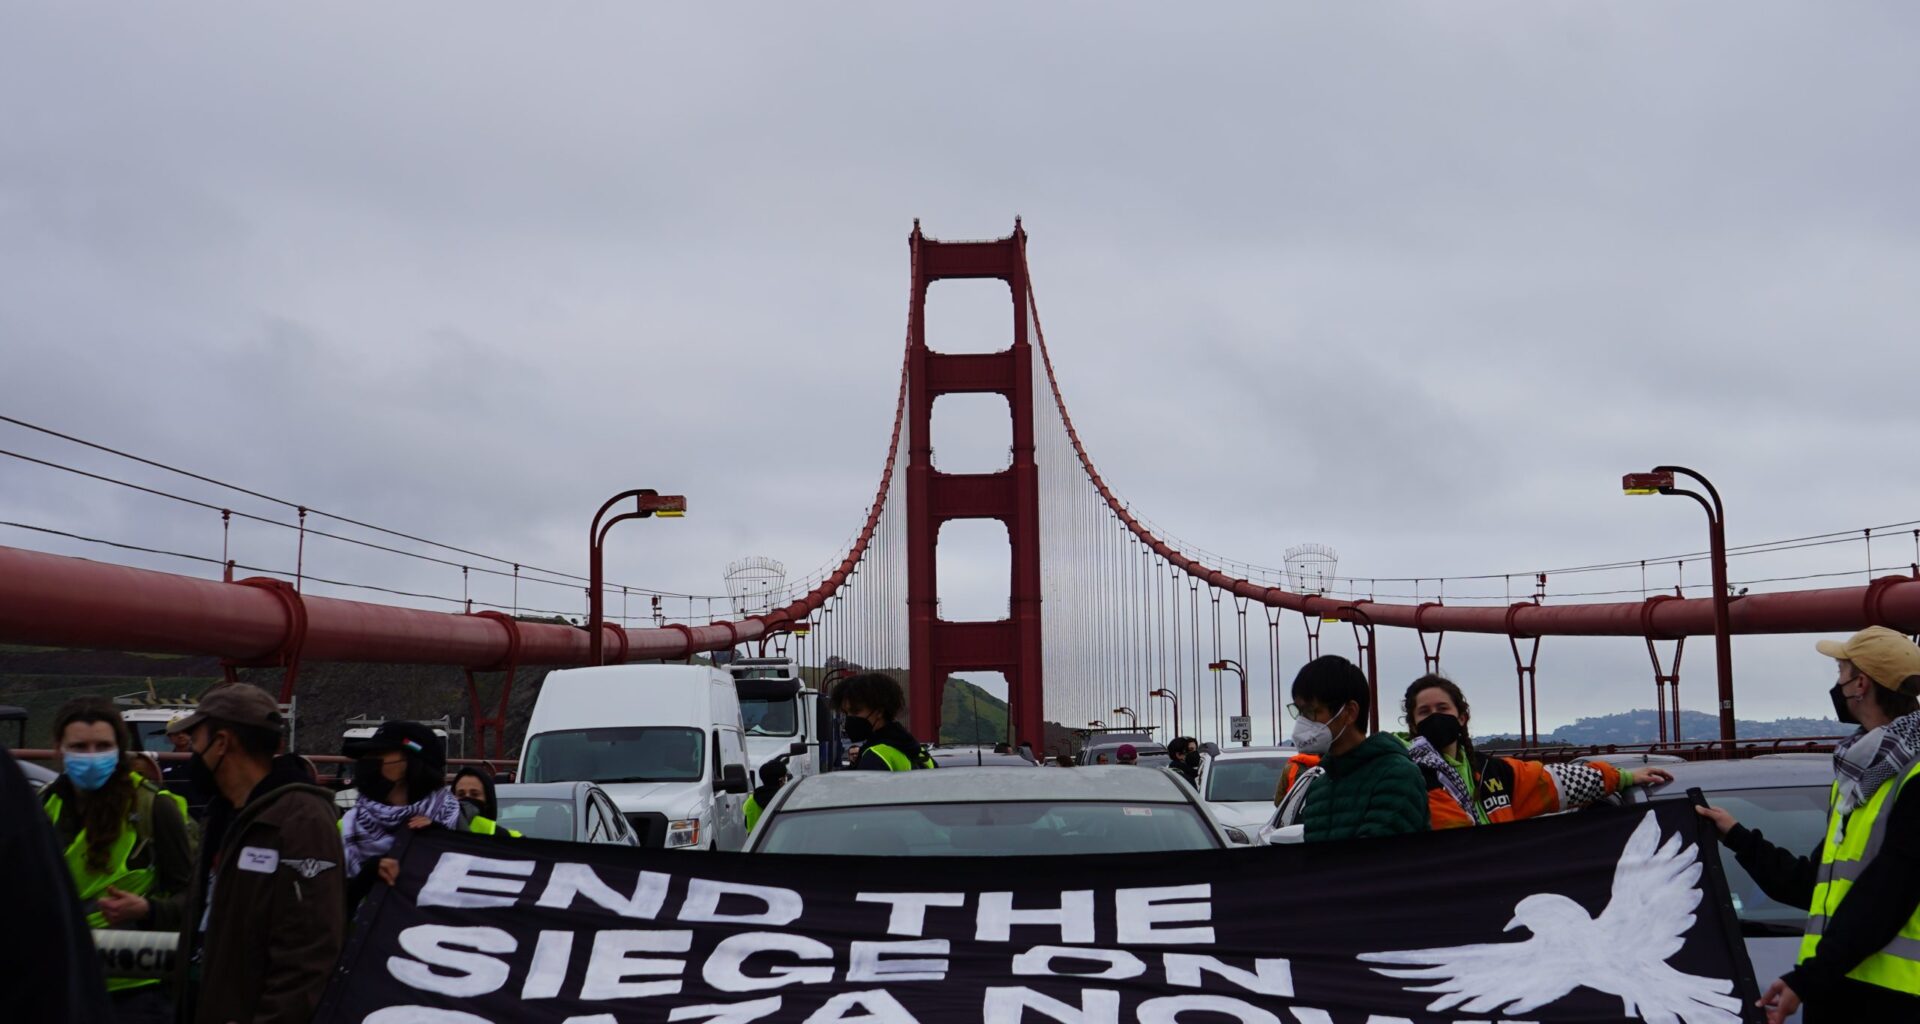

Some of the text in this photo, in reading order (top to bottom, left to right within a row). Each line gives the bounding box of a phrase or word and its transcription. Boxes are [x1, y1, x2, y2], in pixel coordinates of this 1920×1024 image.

[1233, 729, 1249, 740] 45
[417, 853, 1215, 944] END THE
[387, 925, 1294, 1000] SIEGE ON
